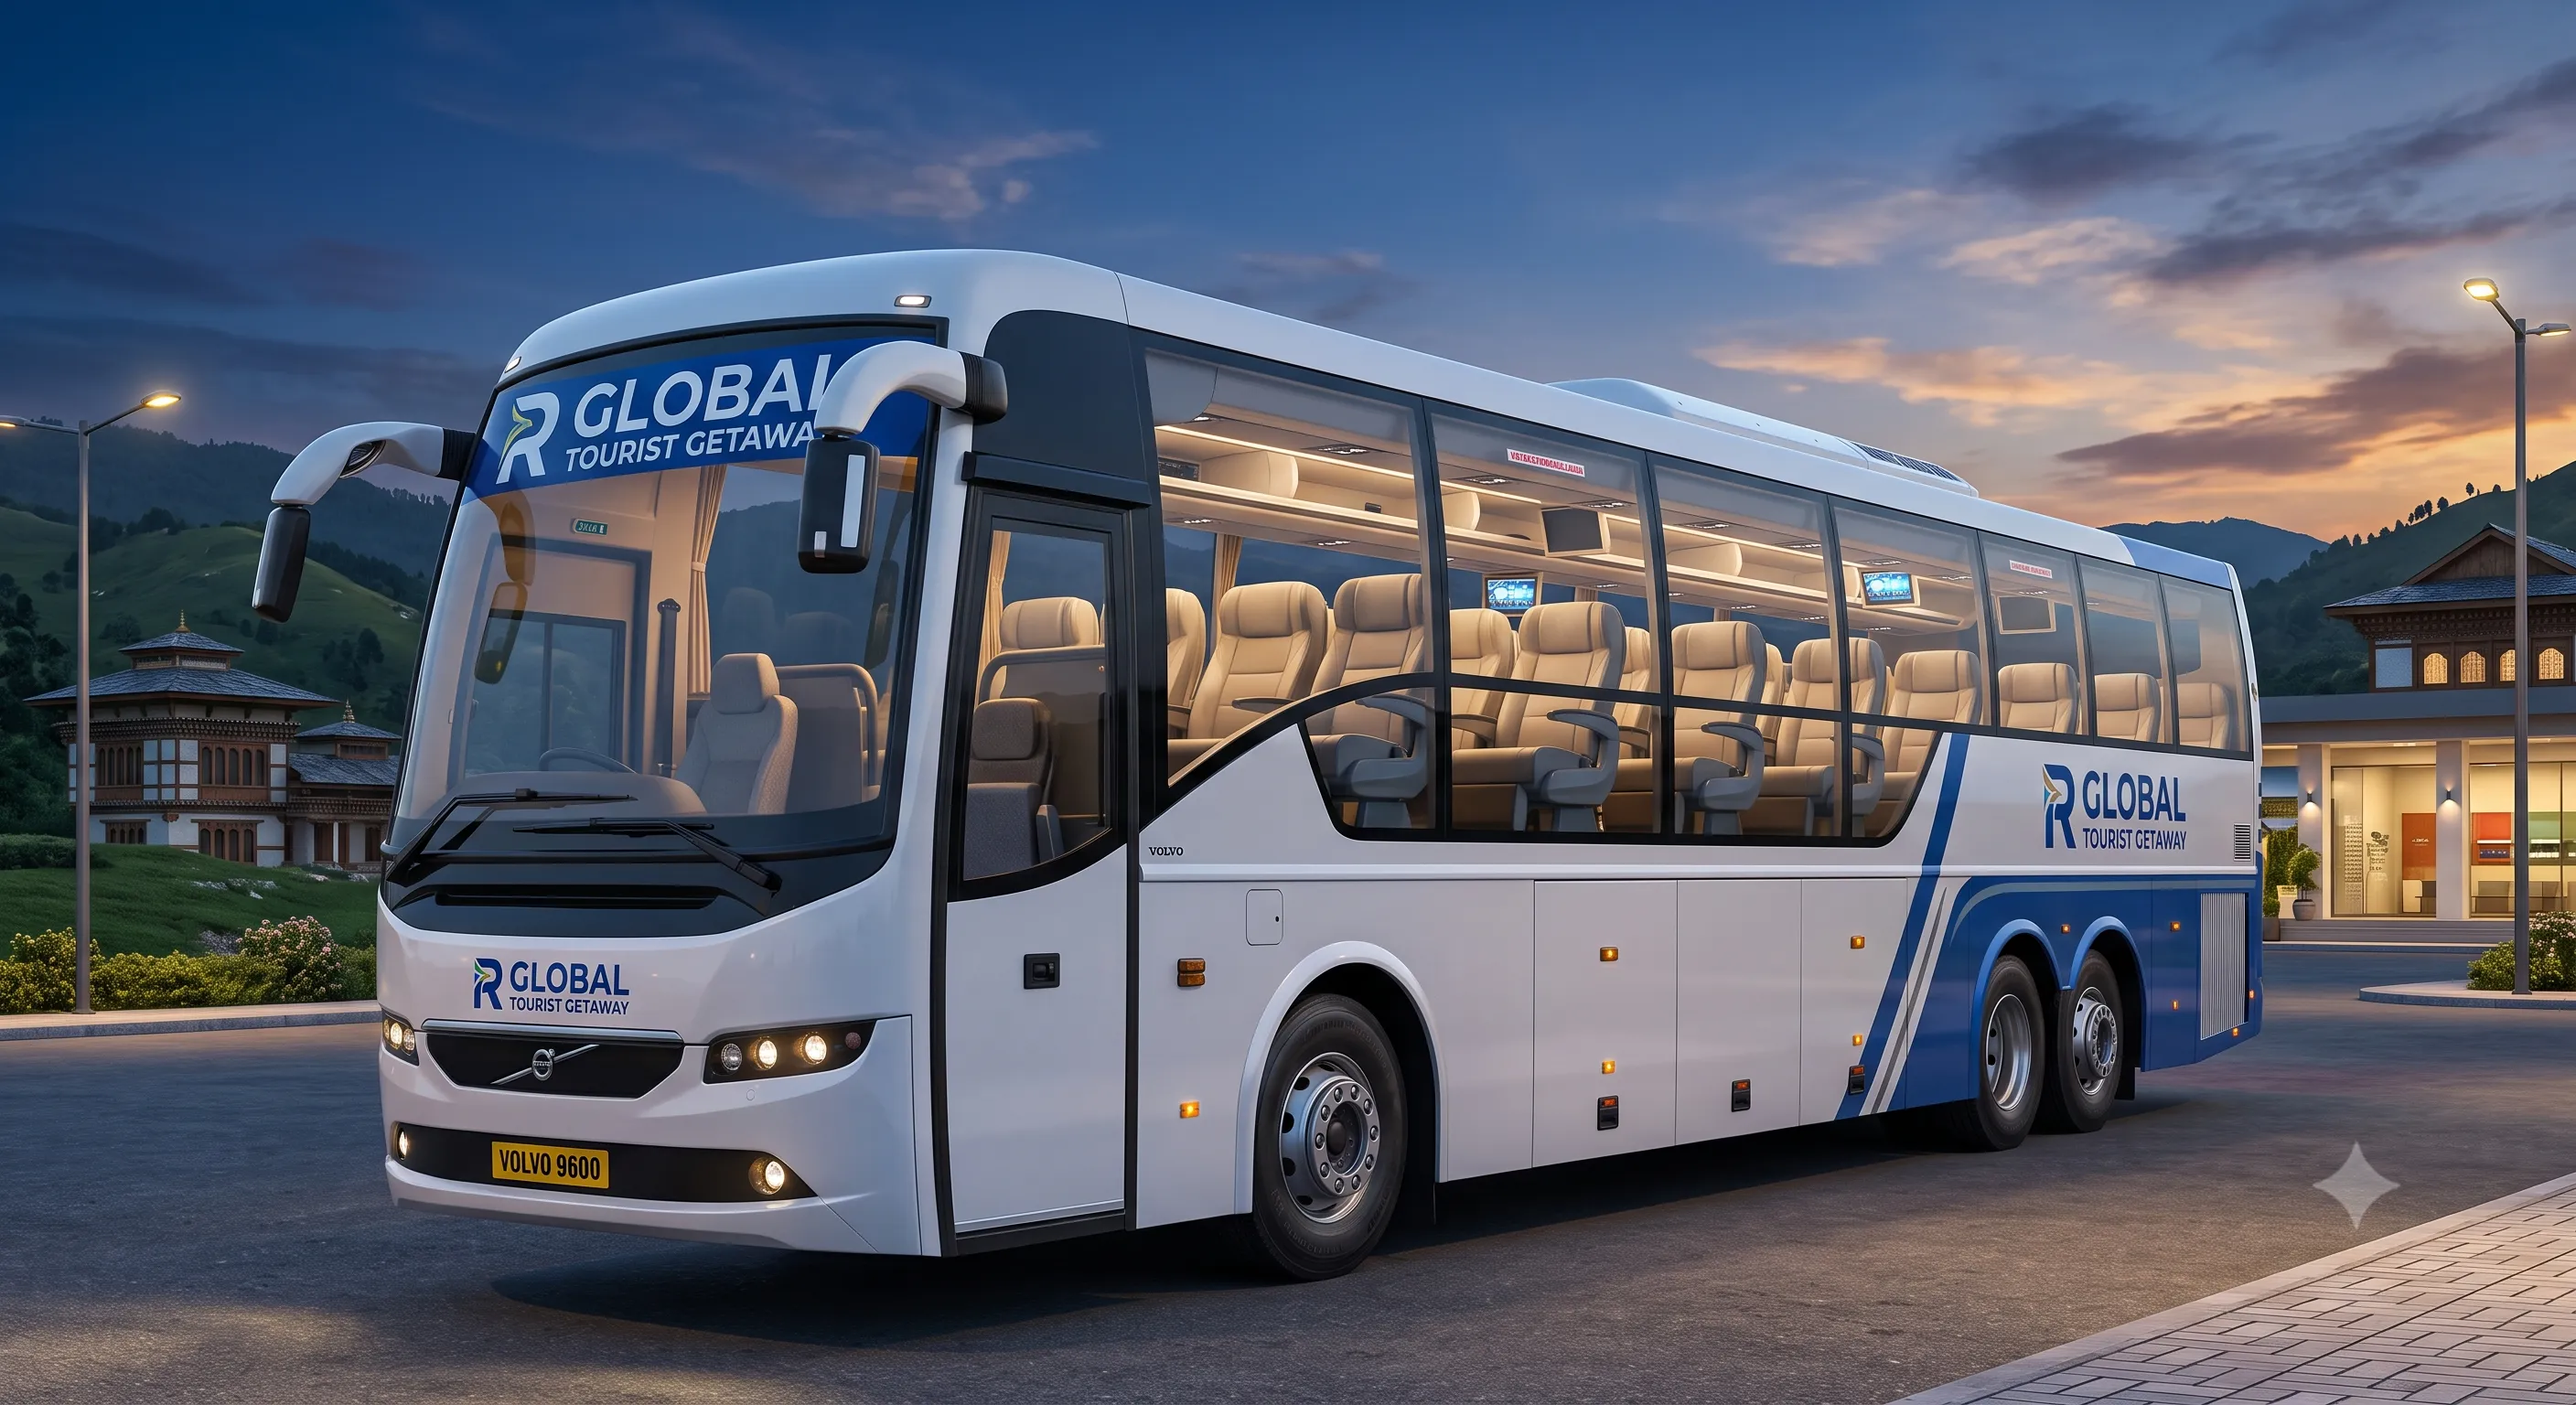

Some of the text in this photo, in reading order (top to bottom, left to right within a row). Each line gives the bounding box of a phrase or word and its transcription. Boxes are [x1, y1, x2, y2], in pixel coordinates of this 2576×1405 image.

[566, 421, 815, 472] TOURIST GETAWA
[2082, 770, 2186, 822] GLOBAL
[1148, 846, 1184, 856] VOLVO
[2083, 828, 2187, 851] TOURIST GETAWAY
[510, 960, 630, 996] GLOBAL
[510, 996, 629, 1015] TOURIST GETAWAY
[499, 1149, 601, 1181] VOLVO 9600
